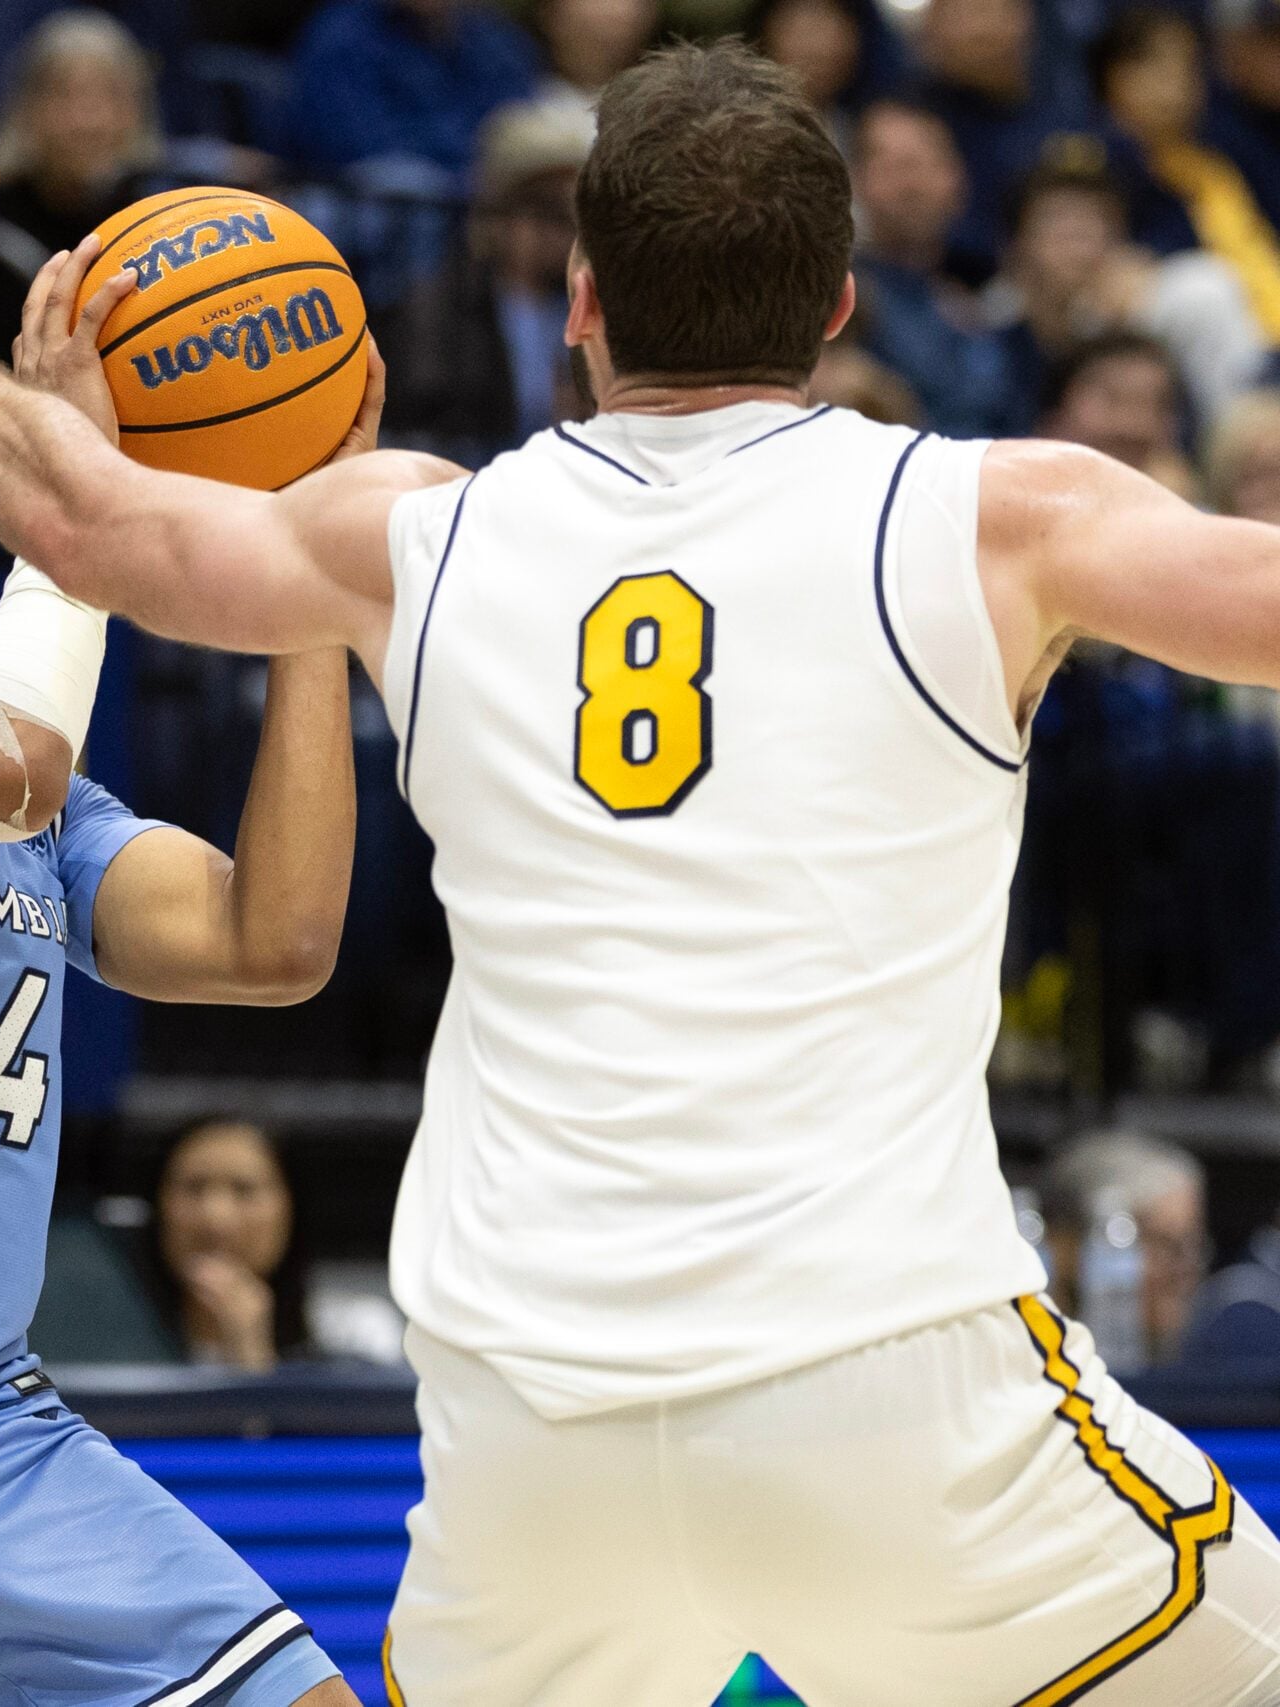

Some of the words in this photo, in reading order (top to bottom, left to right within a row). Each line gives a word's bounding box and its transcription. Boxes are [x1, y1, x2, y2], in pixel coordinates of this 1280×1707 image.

[121, 211, 276, 292] NCAA
[130, 286, 344, 390] Wilson
[200, 306, 231, 325] NXT
[233, 294, 263, 312] EVO
[573, 568, 714, 821] 8
